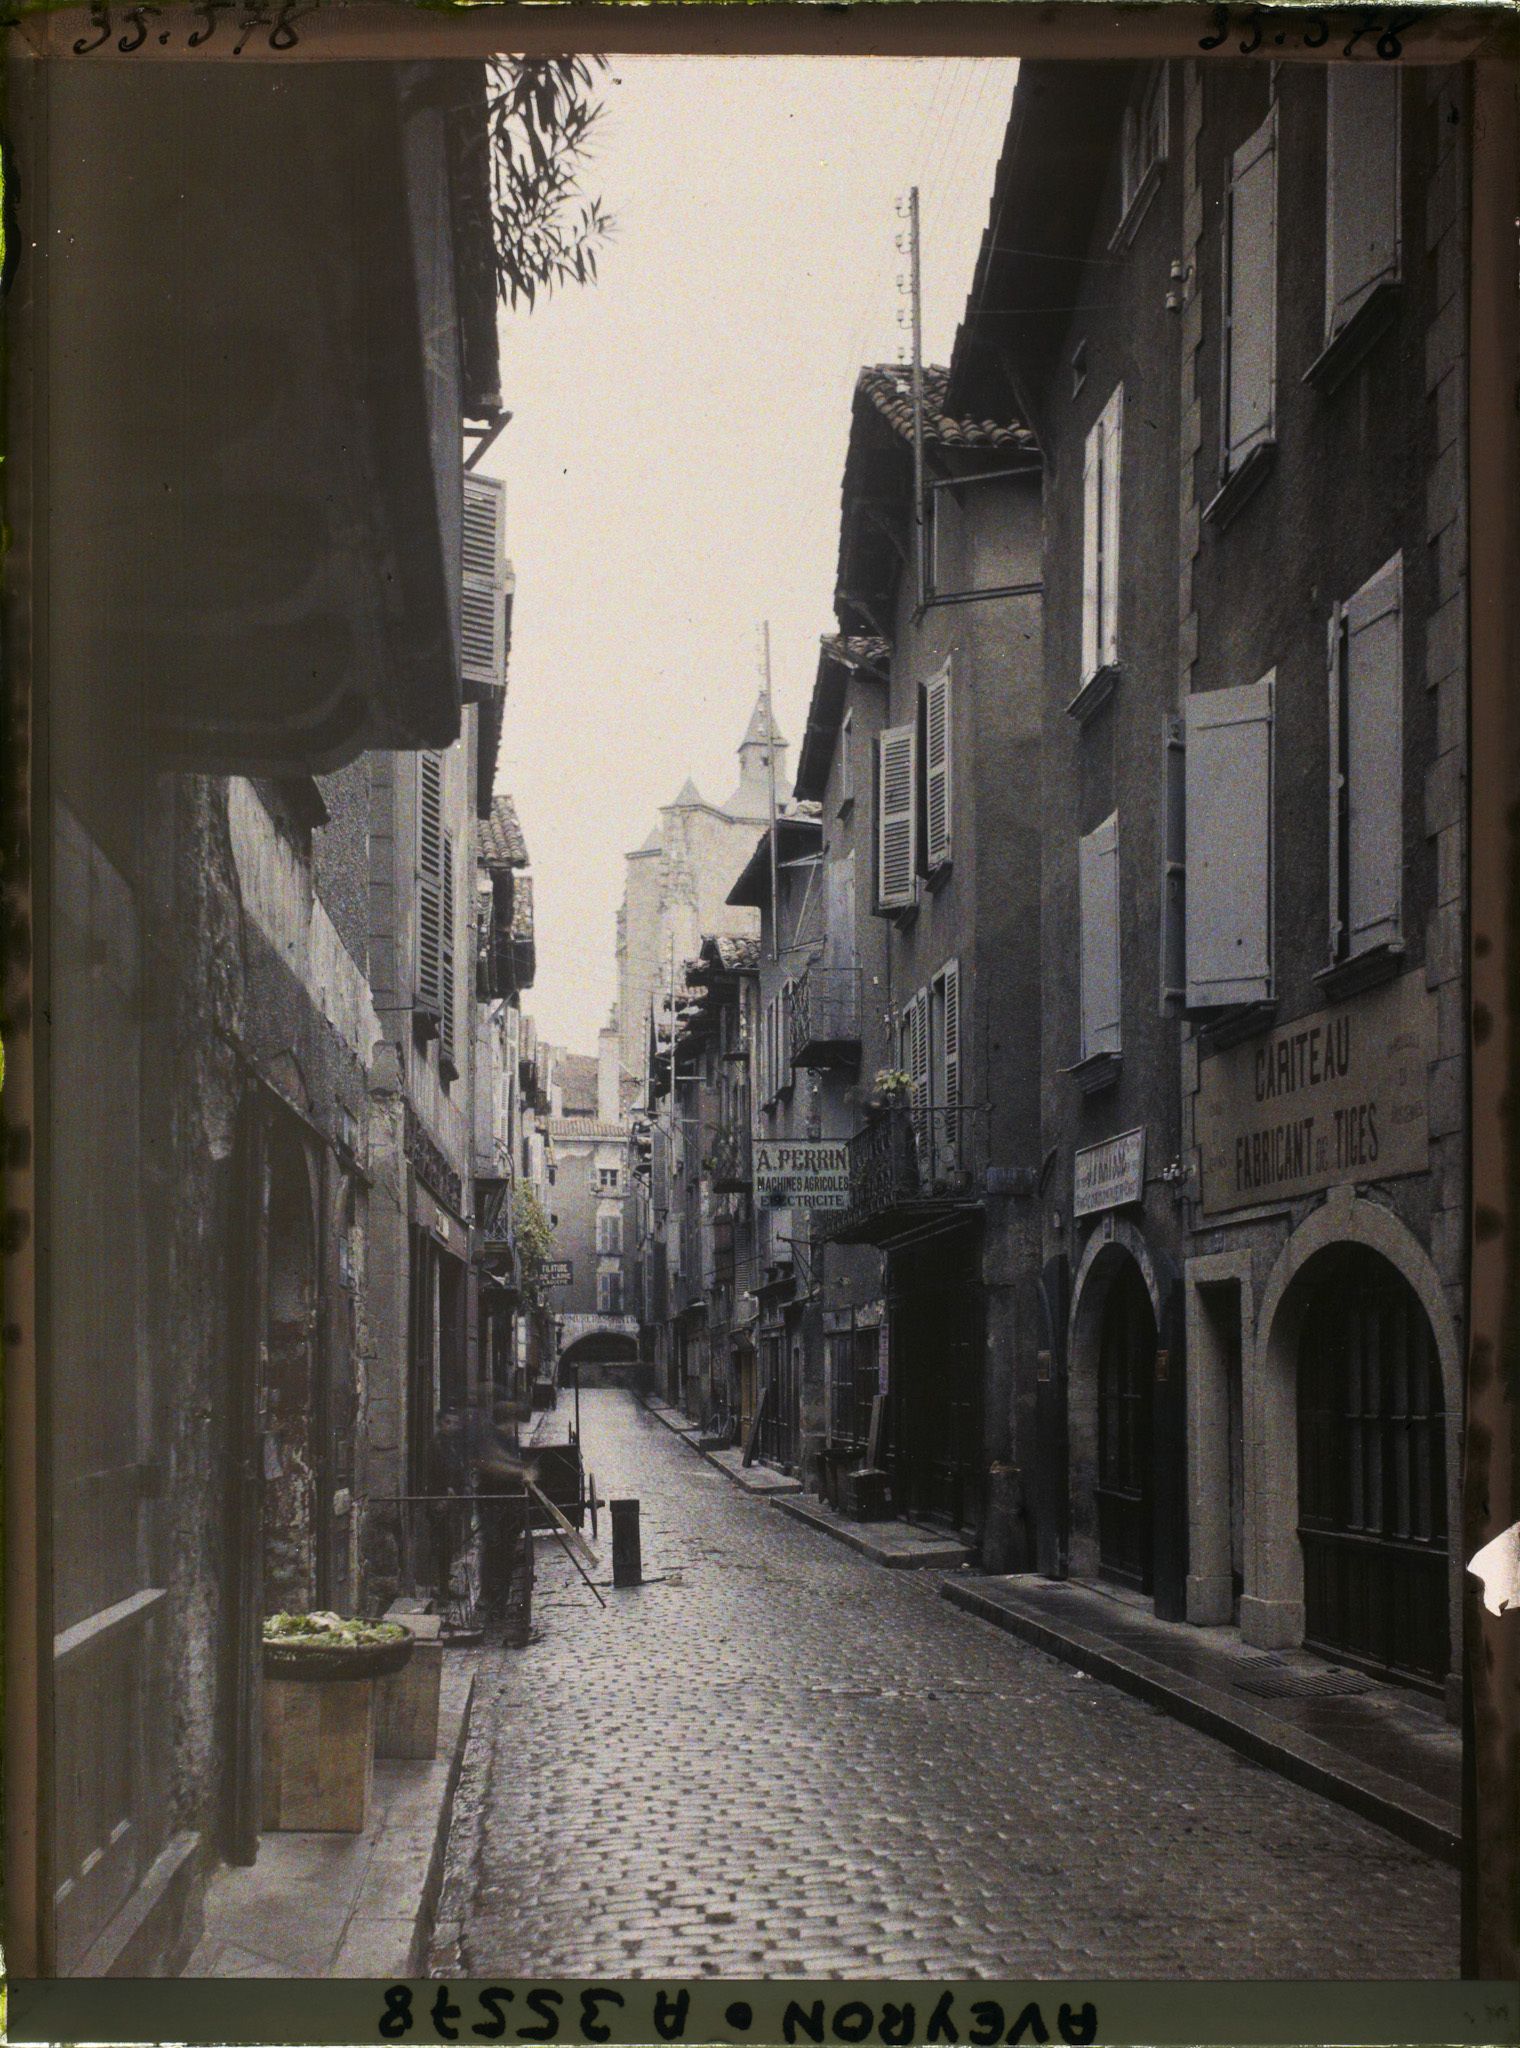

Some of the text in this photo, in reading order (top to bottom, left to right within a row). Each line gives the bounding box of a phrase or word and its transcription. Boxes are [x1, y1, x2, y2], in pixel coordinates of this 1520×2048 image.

[1254, 1015, 1350, 1102] CARITEAU
[757, 1176, 849, 1192] MACHINES AGRICOLES
[1235, 1117, 1314, 1191] FABRICANT
